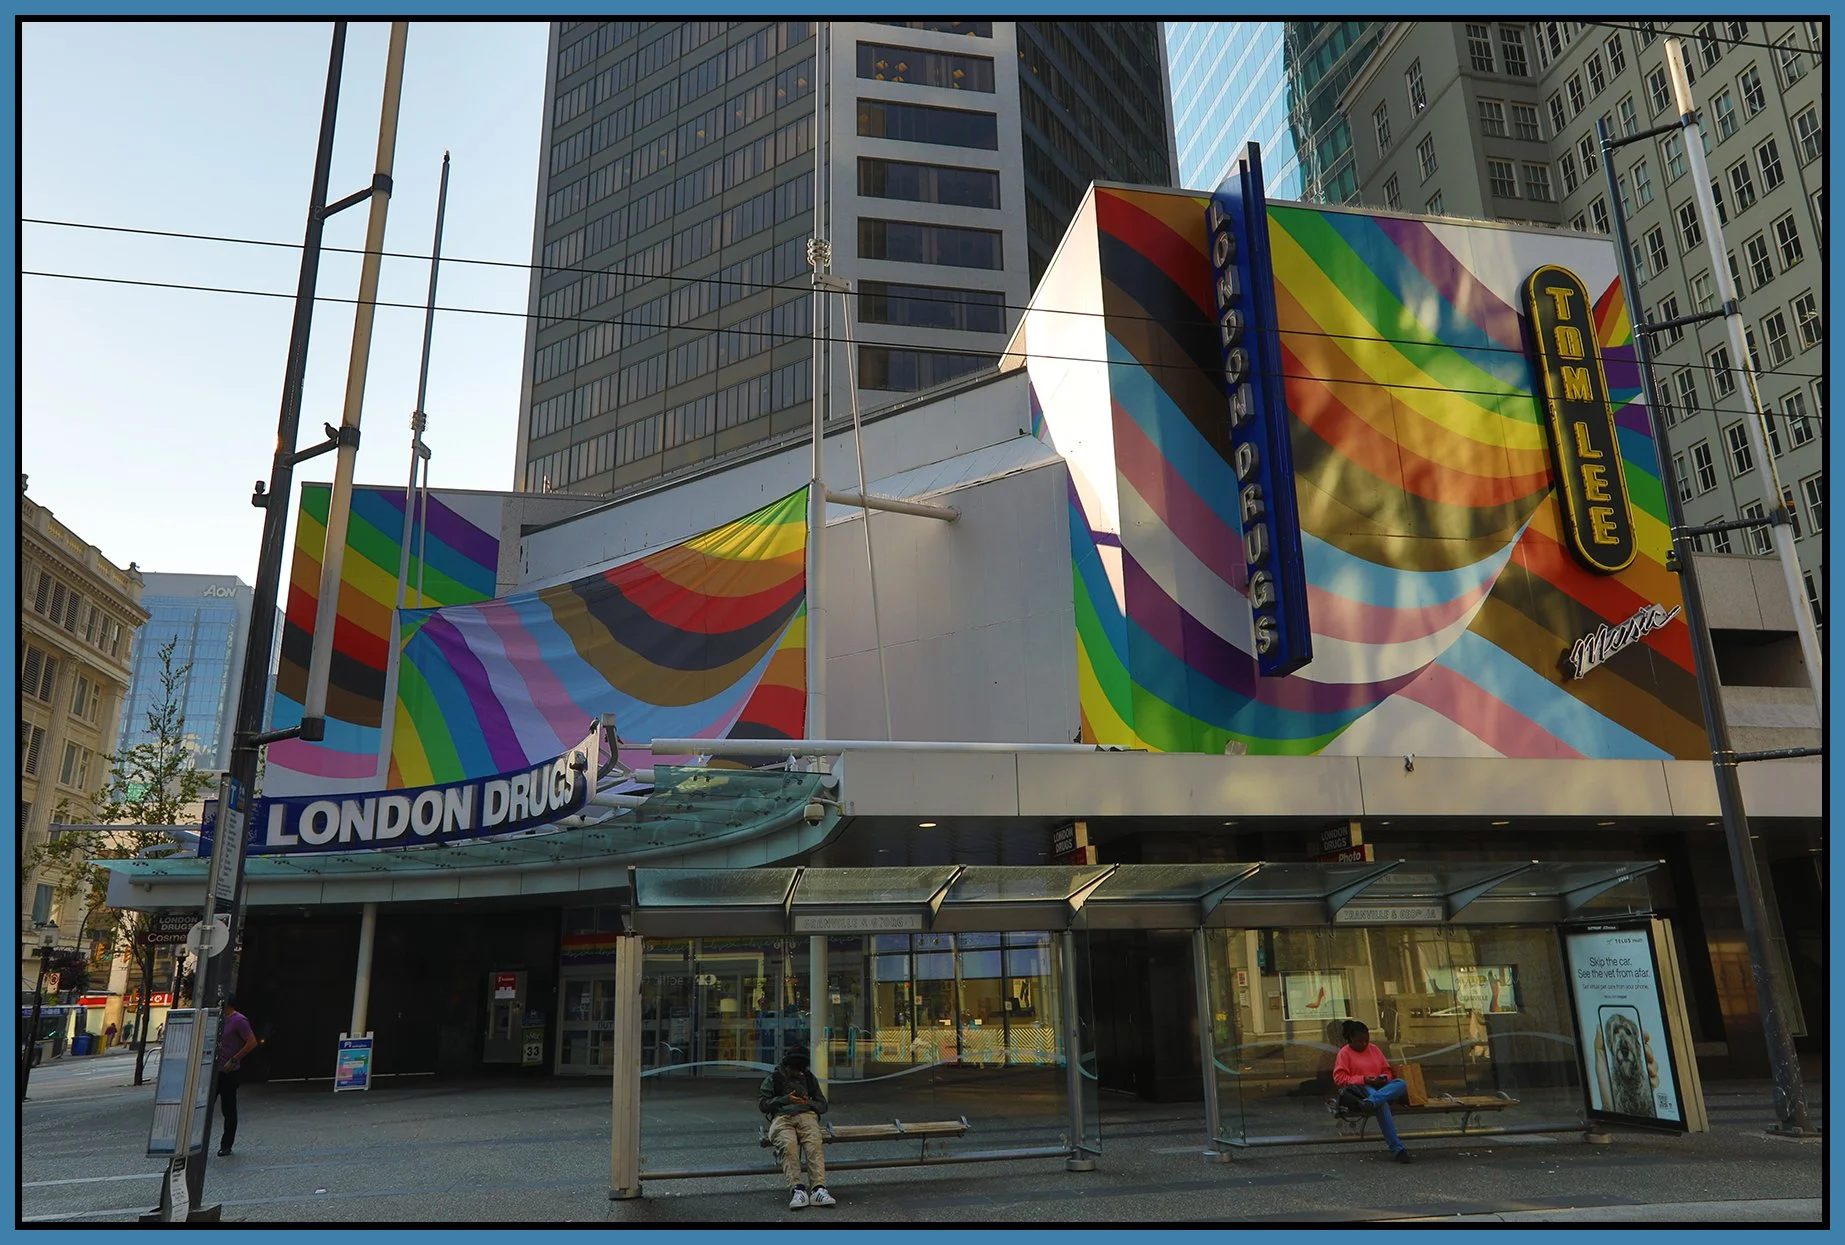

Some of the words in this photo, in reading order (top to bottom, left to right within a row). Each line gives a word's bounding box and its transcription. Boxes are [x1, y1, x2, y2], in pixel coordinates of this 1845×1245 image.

[1546, 286, 1593, 404] TOM
[1573, 421, 1620, 546] LEE
[1210, 202, 1255, 427] LONDON
[1235, 441, 1276, 655] DRUGS
[1570, 604, 1681, 680] Music
[266, 783, 478, 848] LONDON
[483, 750, 588, 828] DRUGS
[1053, 826, 1074, 844] LONDON
[1321, 826, 1349, 841] LONDON
[1324, 837, 1347, 850] DRUGS
[1339, 851, 1362, 864] Photo
[160, 916, 198, 924] LONDON
[161, 923, 192, 931] DRUGS
[147, 933, 187, 942] Cosme
[1589, 957, 1605, 968] Skip
[1606, 957, 1618, 966] the
[1619, 958, 1632, 966] car.
[1577, 968, 1591, 978] See
[1591, 969, 1603, 978] the
[1604, 970, 1615, 978] vet
[1615, 968, 1634, 978] from
[1634, 968, 1650, 978] afar.
[597, 1021, 613, 1029] OUT
